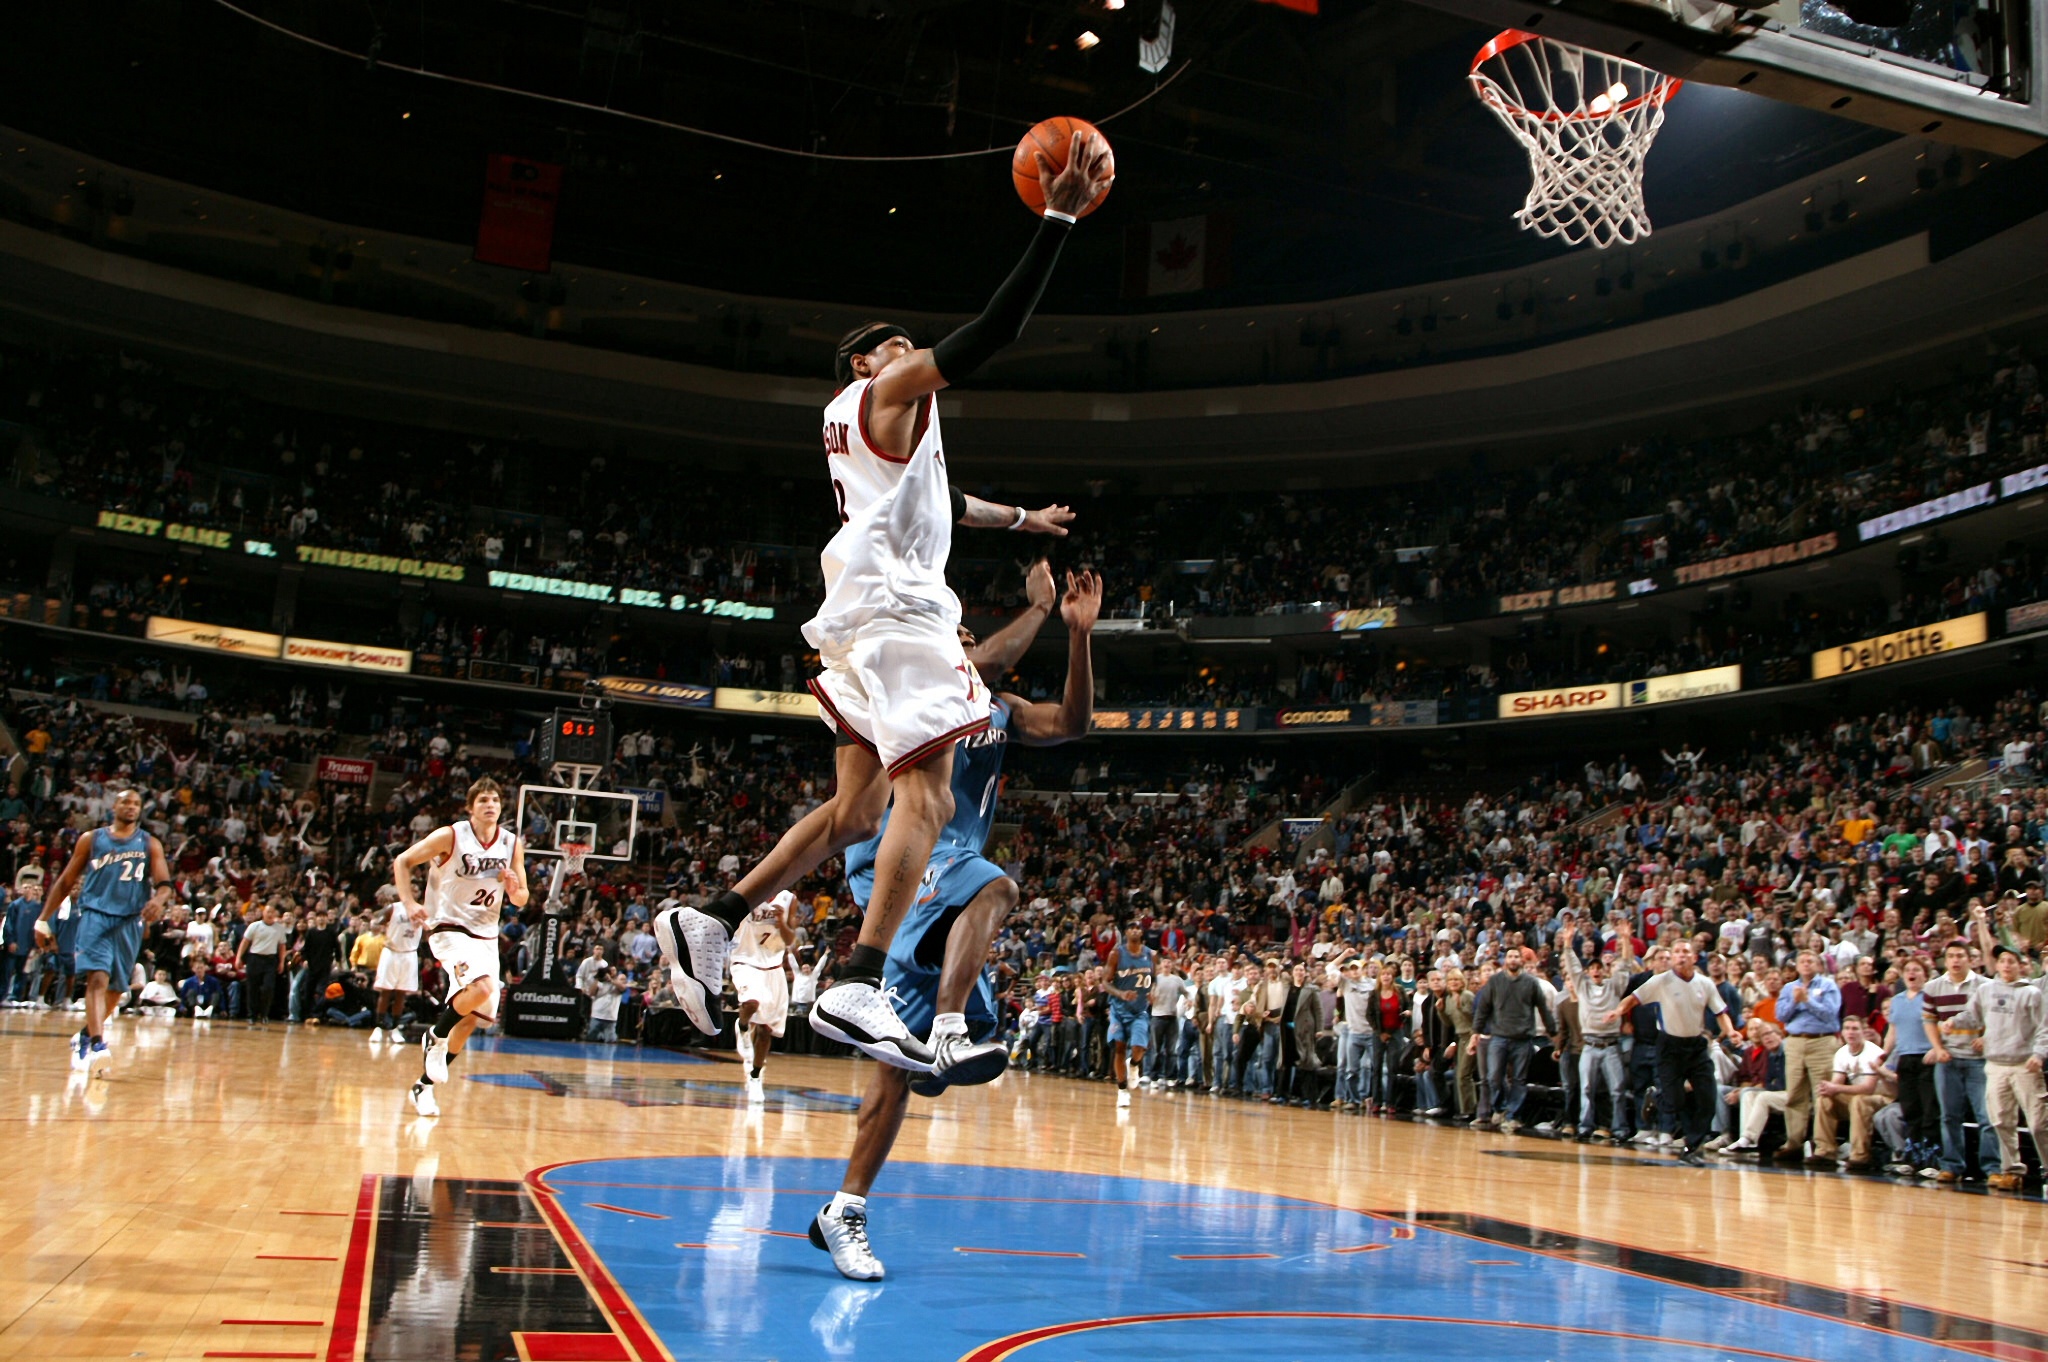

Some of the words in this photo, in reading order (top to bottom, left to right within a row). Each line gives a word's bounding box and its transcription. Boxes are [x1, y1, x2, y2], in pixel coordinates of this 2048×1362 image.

[97, 510, 163, 537] NEXT
[166, 522, 232, 549] GAME
[296, 545, 465, 582] TIMBERWOLVES
[488, 570, 615, 604] WEDNESDAY,
[620, 587, 666, 609] DEC.
[670, 594, 687, 611] 8
[647, 685, 710, 700] LIGHT
[1513, 689, 1608, 713] SHARP
[1281, 708, 1351, 726] comcast
[979, 774, 996, 819] 0
[119, 860, 145, 881] 24
[470, 888, 498, 908] 26
[759, 932, 772, 945] 7
[1135, 974, 1152, 989] 20
[513, 992, 577, 1005] OfficeMax
